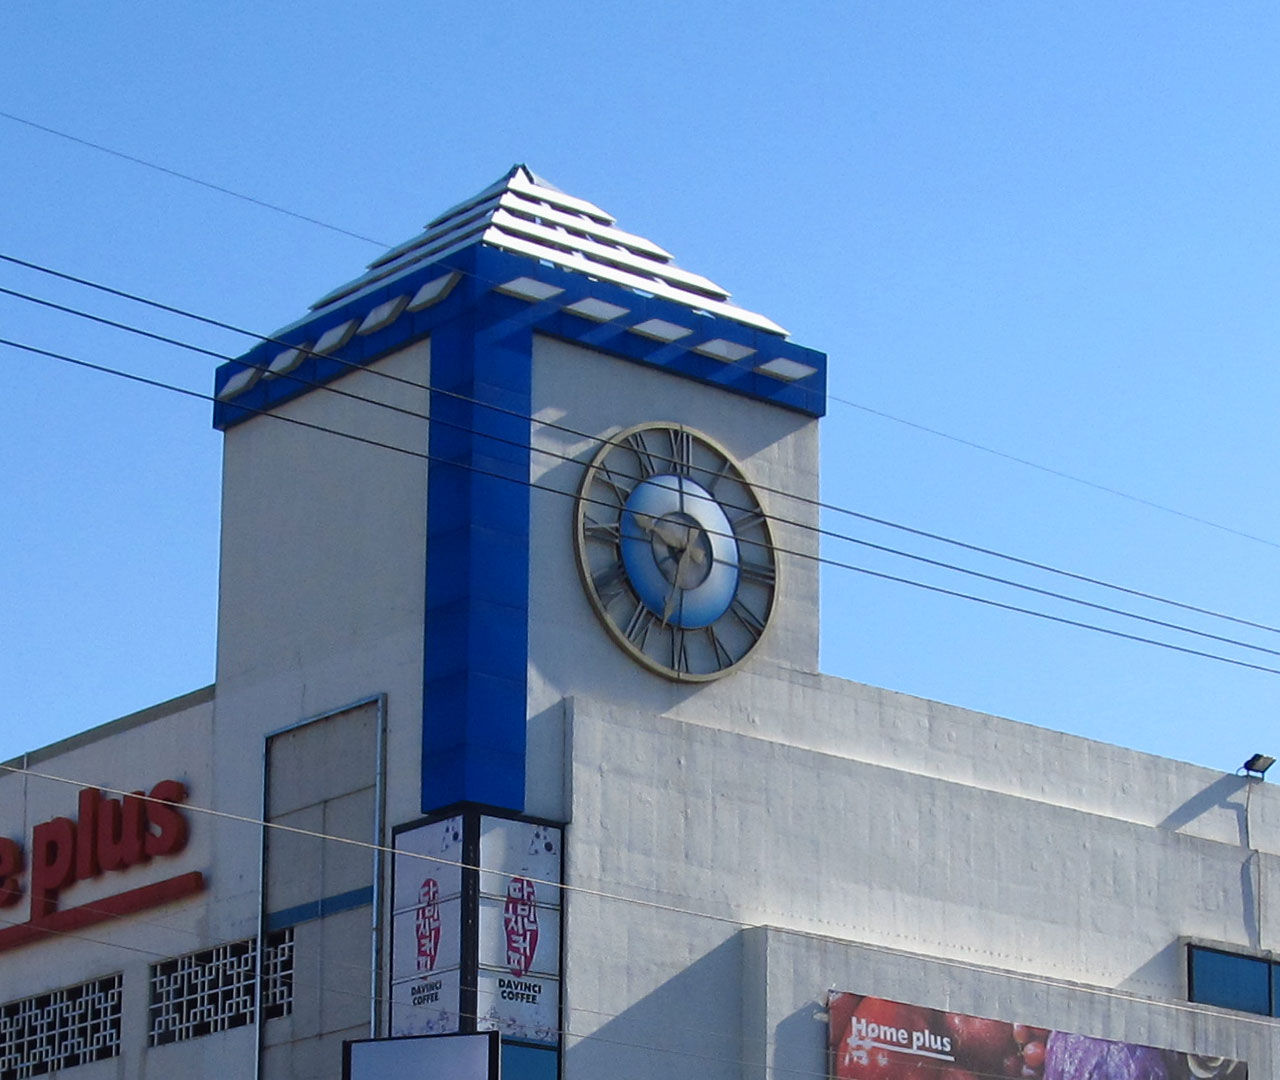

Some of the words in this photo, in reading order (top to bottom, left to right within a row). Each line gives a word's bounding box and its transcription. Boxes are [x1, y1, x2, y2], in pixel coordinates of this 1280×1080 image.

[29, 779, 188, 922] plus
[411, 980, 442, 995] DAVINCI
[498, 978, 542, 995] DAVINCI
[412, 993, 439, 1006] COFFEE
[501, 990, 537, 1005] COFFEE
[851, 1016, 909, 1044] Home
[912, 1030, 952, 1052] plus
